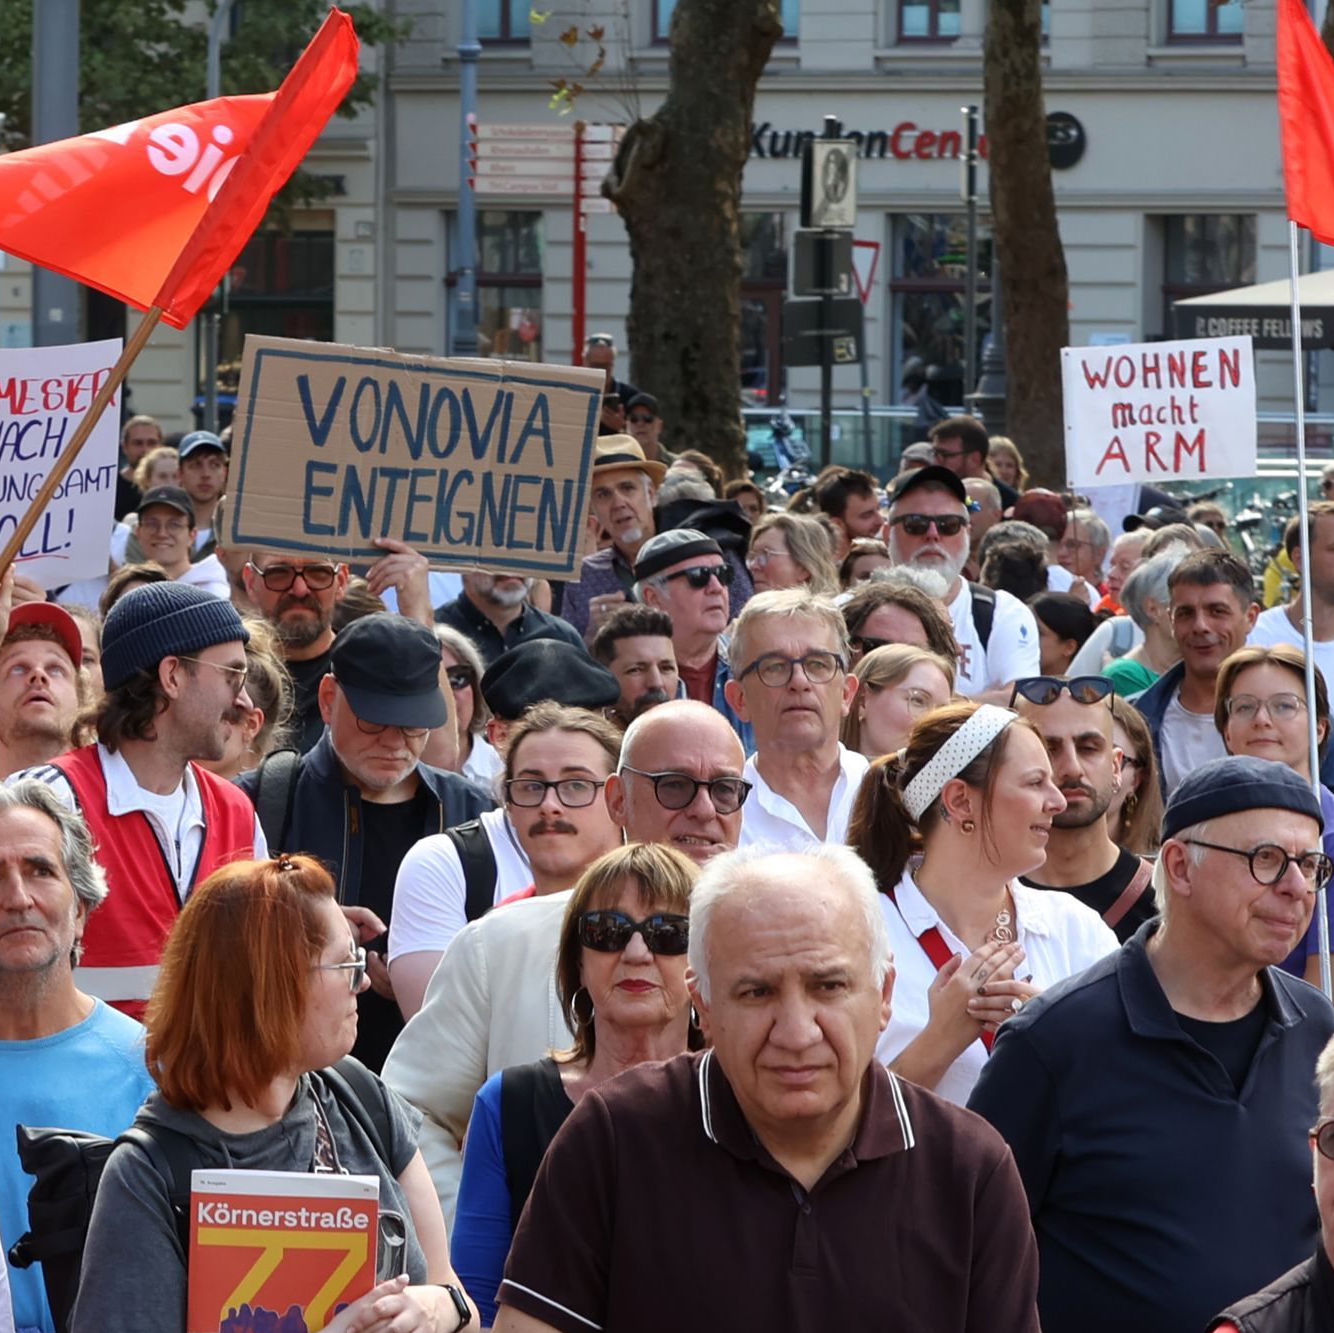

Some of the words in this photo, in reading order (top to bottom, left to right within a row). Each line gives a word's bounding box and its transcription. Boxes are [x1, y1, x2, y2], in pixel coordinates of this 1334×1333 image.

[1262, 318, 1324, 338] FELLWS
[1081, 348, 1240, 389] WOHNEN
[296, 374, 554, 467] VONOVIA
[1111, 394, 1199, 429] macht
[1095, 428, 1207, 475] ARM
[303, 460, 574, 553] ENTEIGNEN
[198, 1202, 369, 1229] Körnerstraße
